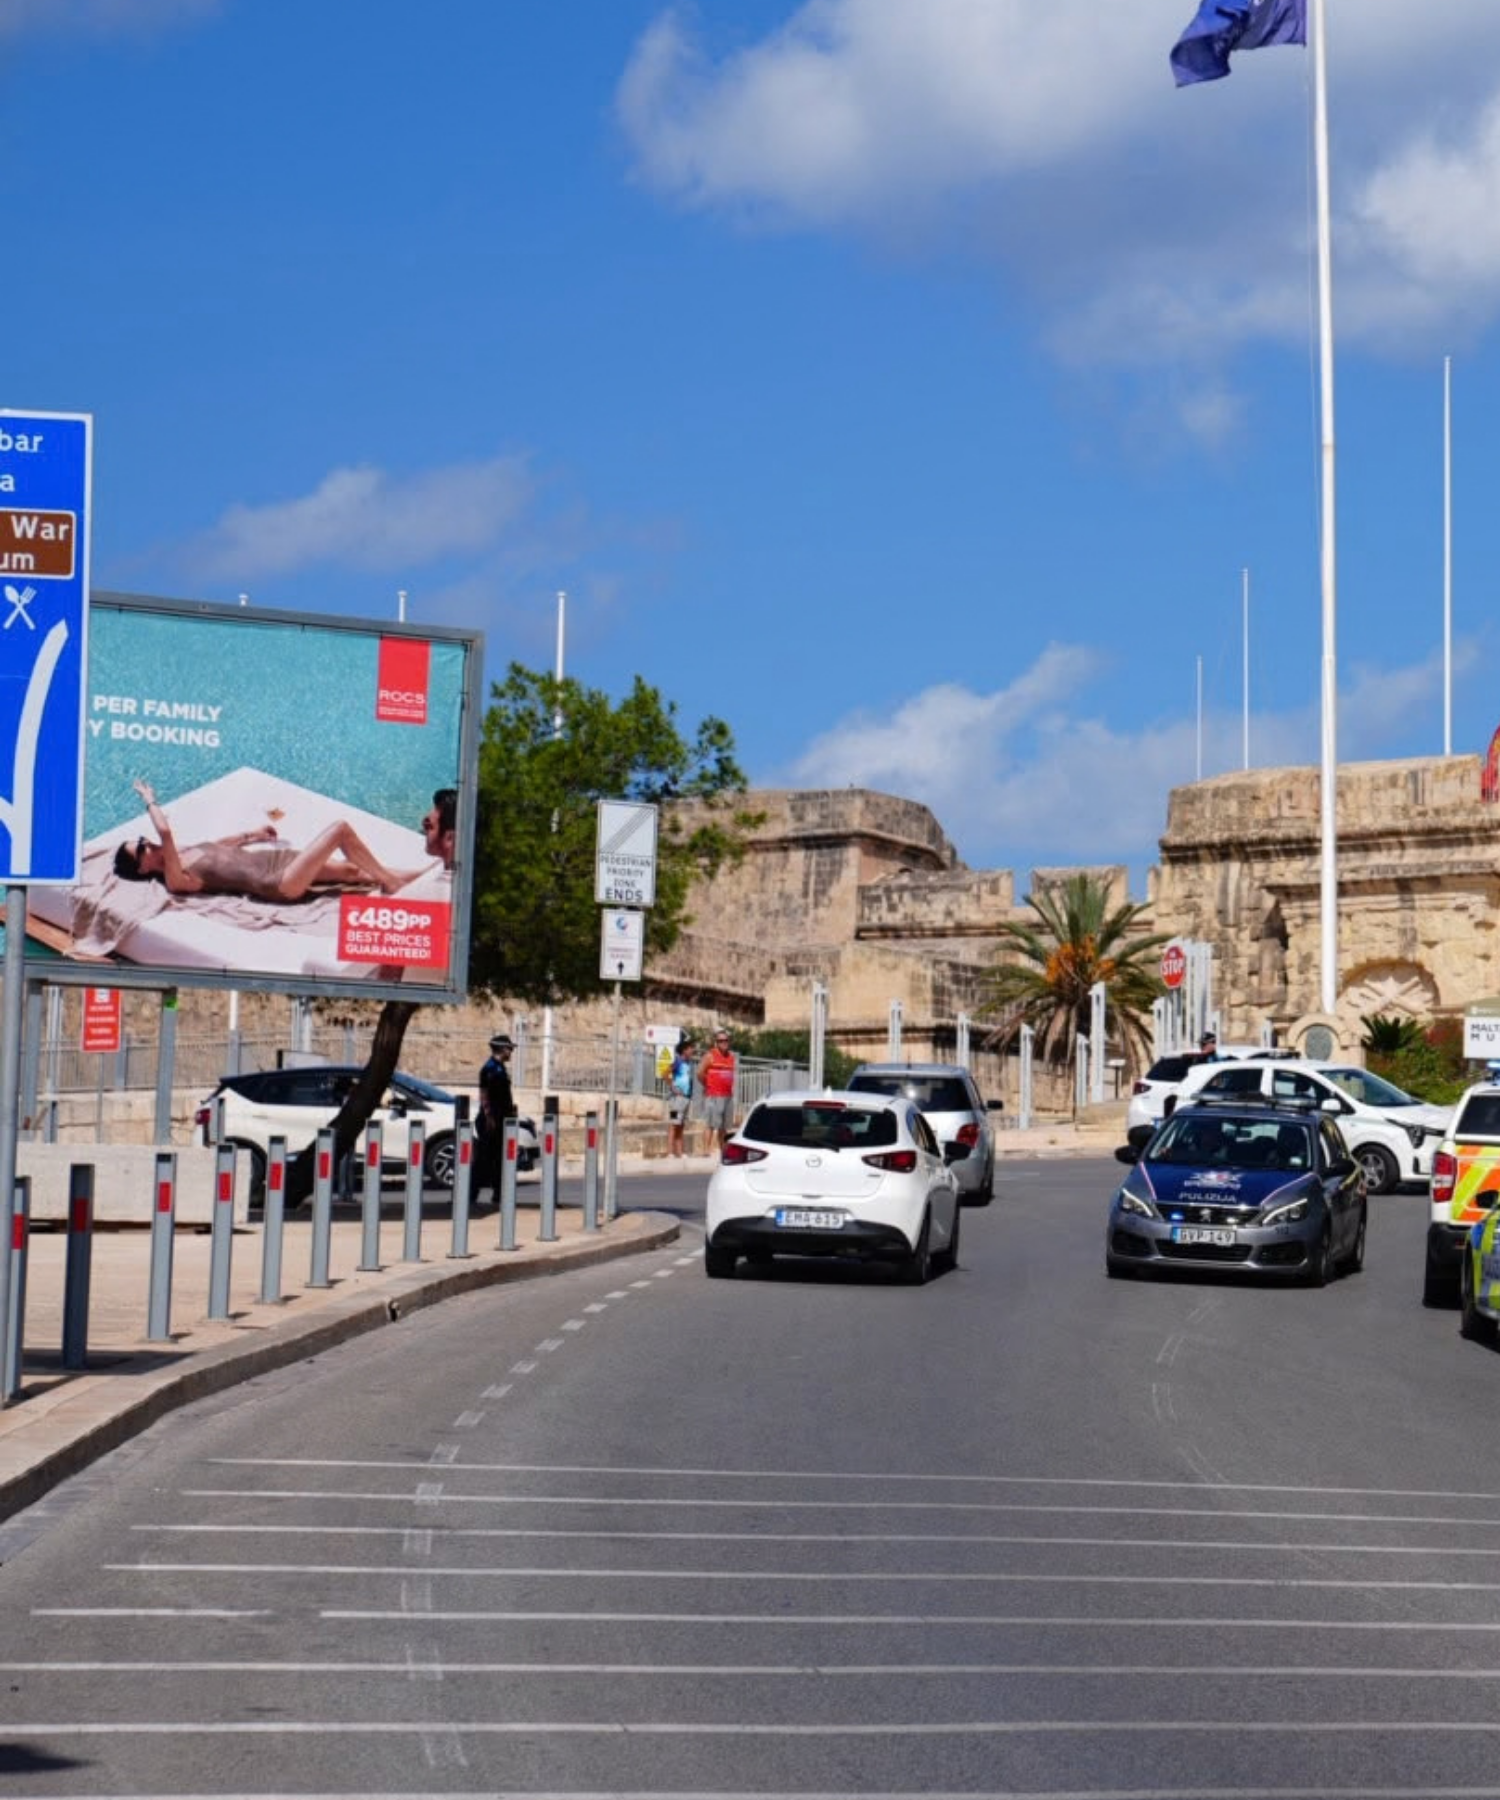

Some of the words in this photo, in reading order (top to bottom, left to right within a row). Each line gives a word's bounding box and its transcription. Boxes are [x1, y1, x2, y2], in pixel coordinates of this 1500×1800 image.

[11, 515, 70, 541] War
[380, 690, 425, 703] ROCS
[93, 695, 137, 714] PER
[143, 699, 222, 722] FAMILY
[111, 721, 220, 747] BOOKING
[600, 855, 650, 867] PEDESTRIAN
[605, 888, 643, 901] ENDS
[346, 930, 380, 944] BEST
[384, 933, 431, 947] PRICES
[1162, 958, 1184, 976] STOP
